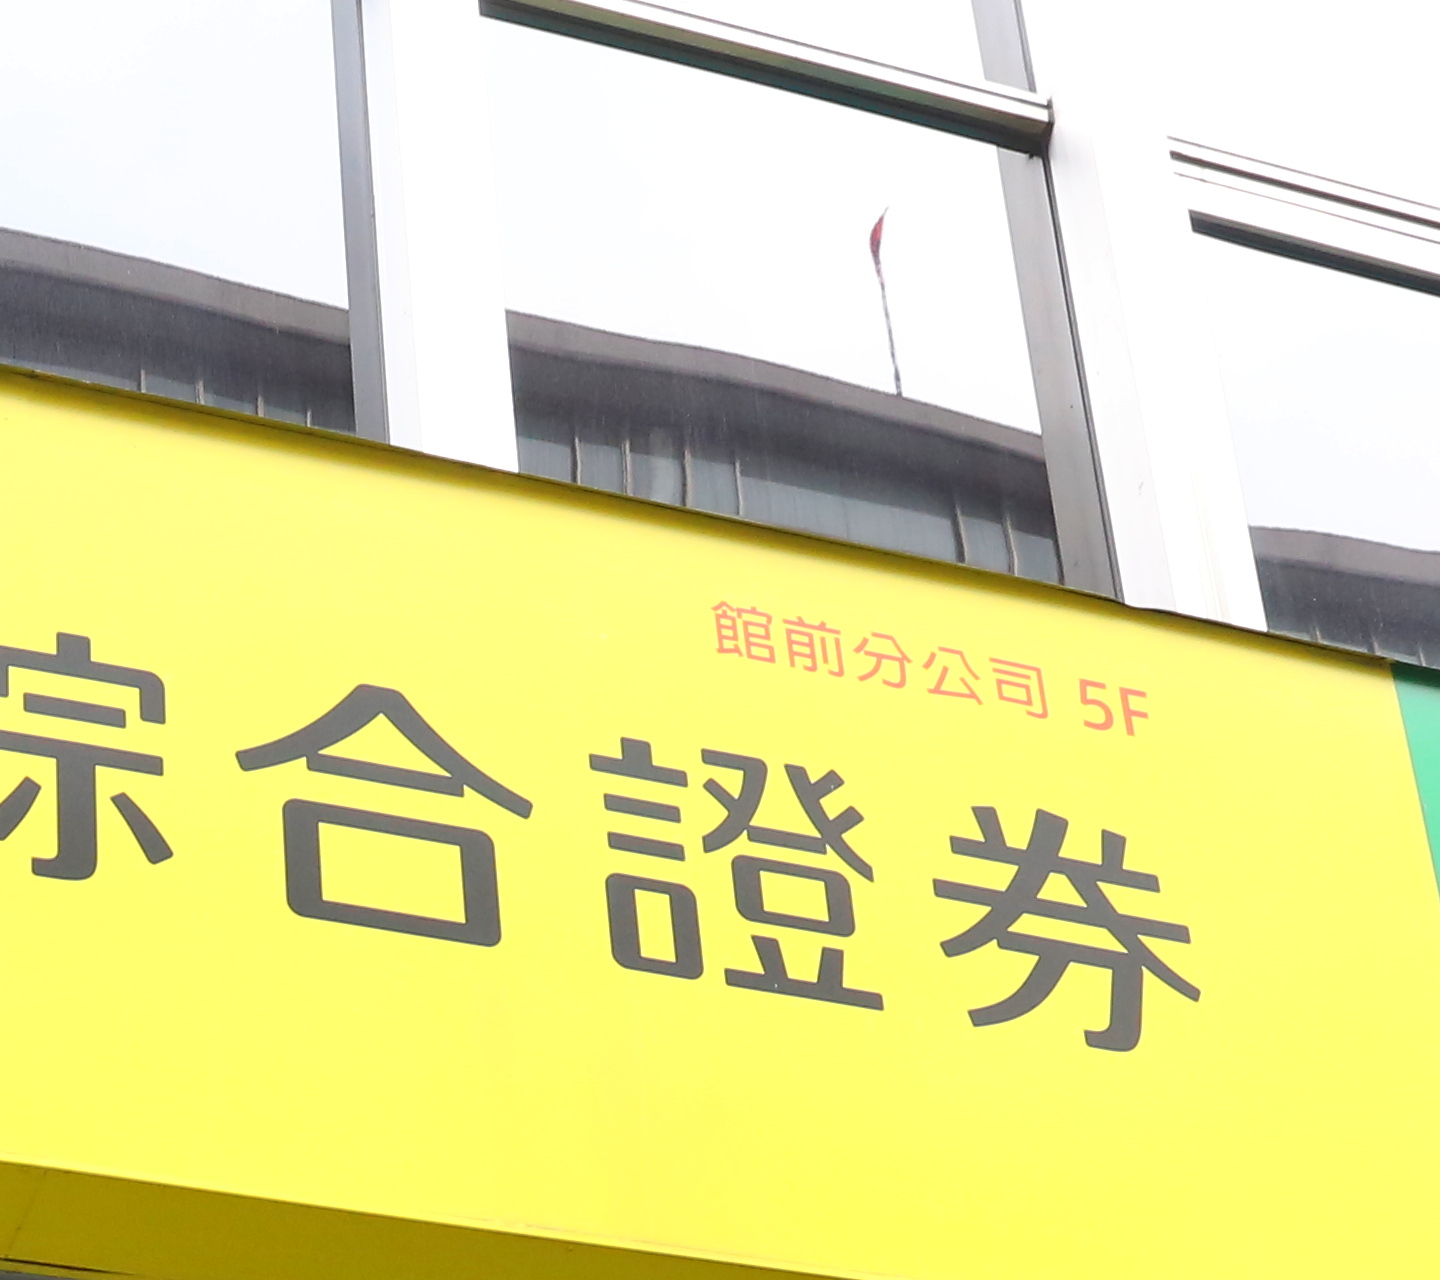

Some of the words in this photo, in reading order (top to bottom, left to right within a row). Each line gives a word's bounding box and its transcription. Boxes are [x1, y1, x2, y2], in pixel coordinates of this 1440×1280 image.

[710, 600, 1050, 720] 館前分公司
[1077, 677, 1150, 738] 5F
